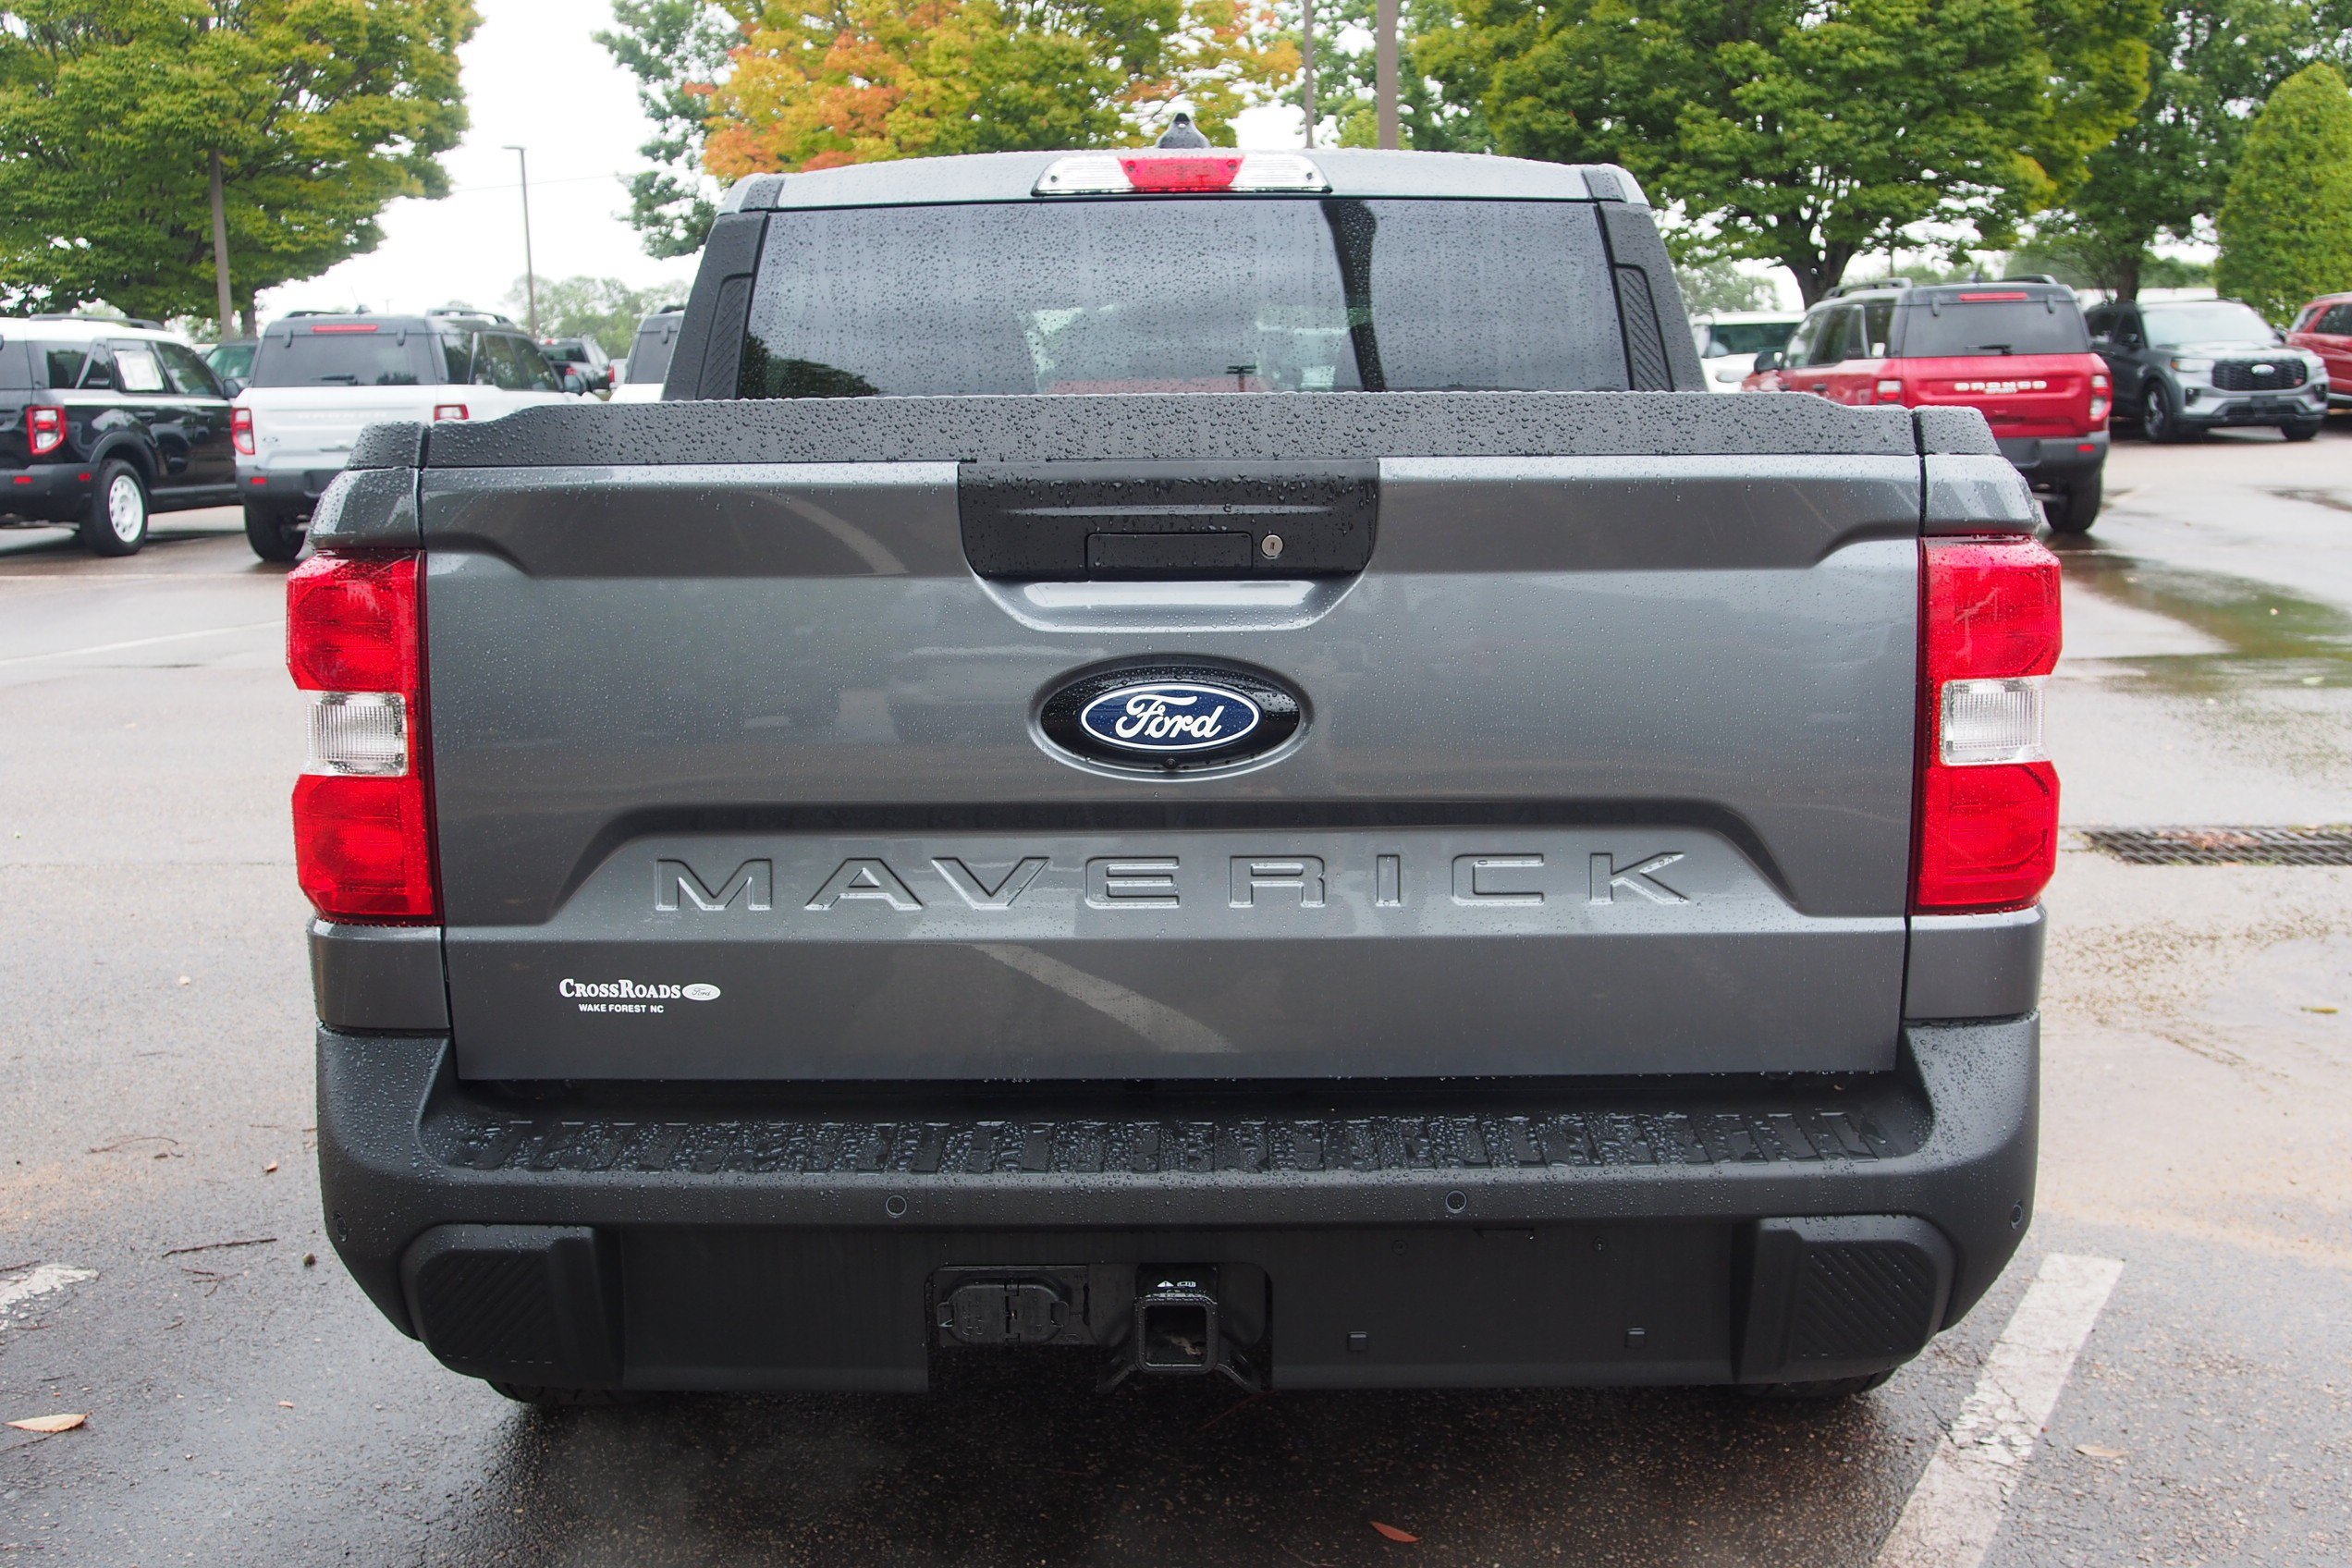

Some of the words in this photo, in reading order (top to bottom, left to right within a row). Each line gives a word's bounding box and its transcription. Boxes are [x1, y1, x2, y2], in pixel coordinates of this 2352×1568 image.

[1115, 694, 1225, 739] Ford
[655, 851, 1690, 911] MAVERICK
[579, 1003, 607, 1012] WAKE
[608, 1004, 647, 1013] FOREST
[650, 1004, 665, 1013] NC
